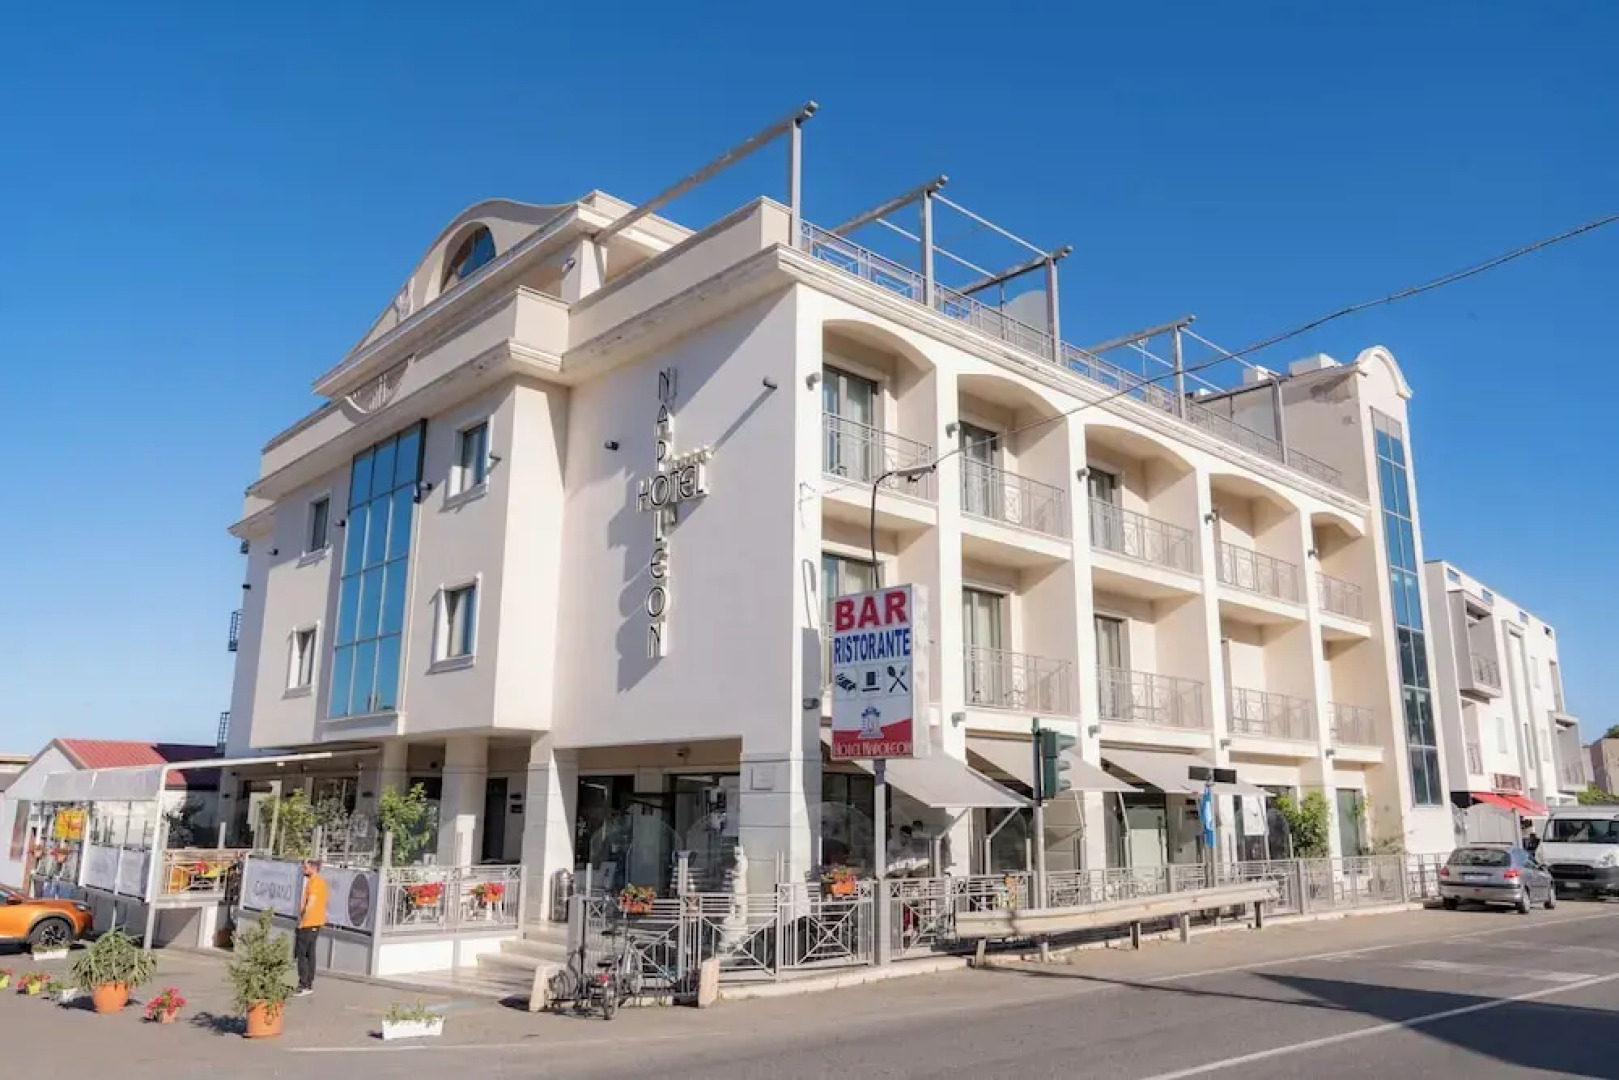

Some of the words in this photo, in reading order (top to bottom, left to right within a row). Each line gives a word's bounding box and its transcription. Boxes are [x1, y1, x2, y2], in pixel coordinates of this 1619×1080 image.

[636, 463, 709, 512] HOTEL
[834, 590, 908, 632] BAR
[834, 628, 911, 663] RISTORANTE
